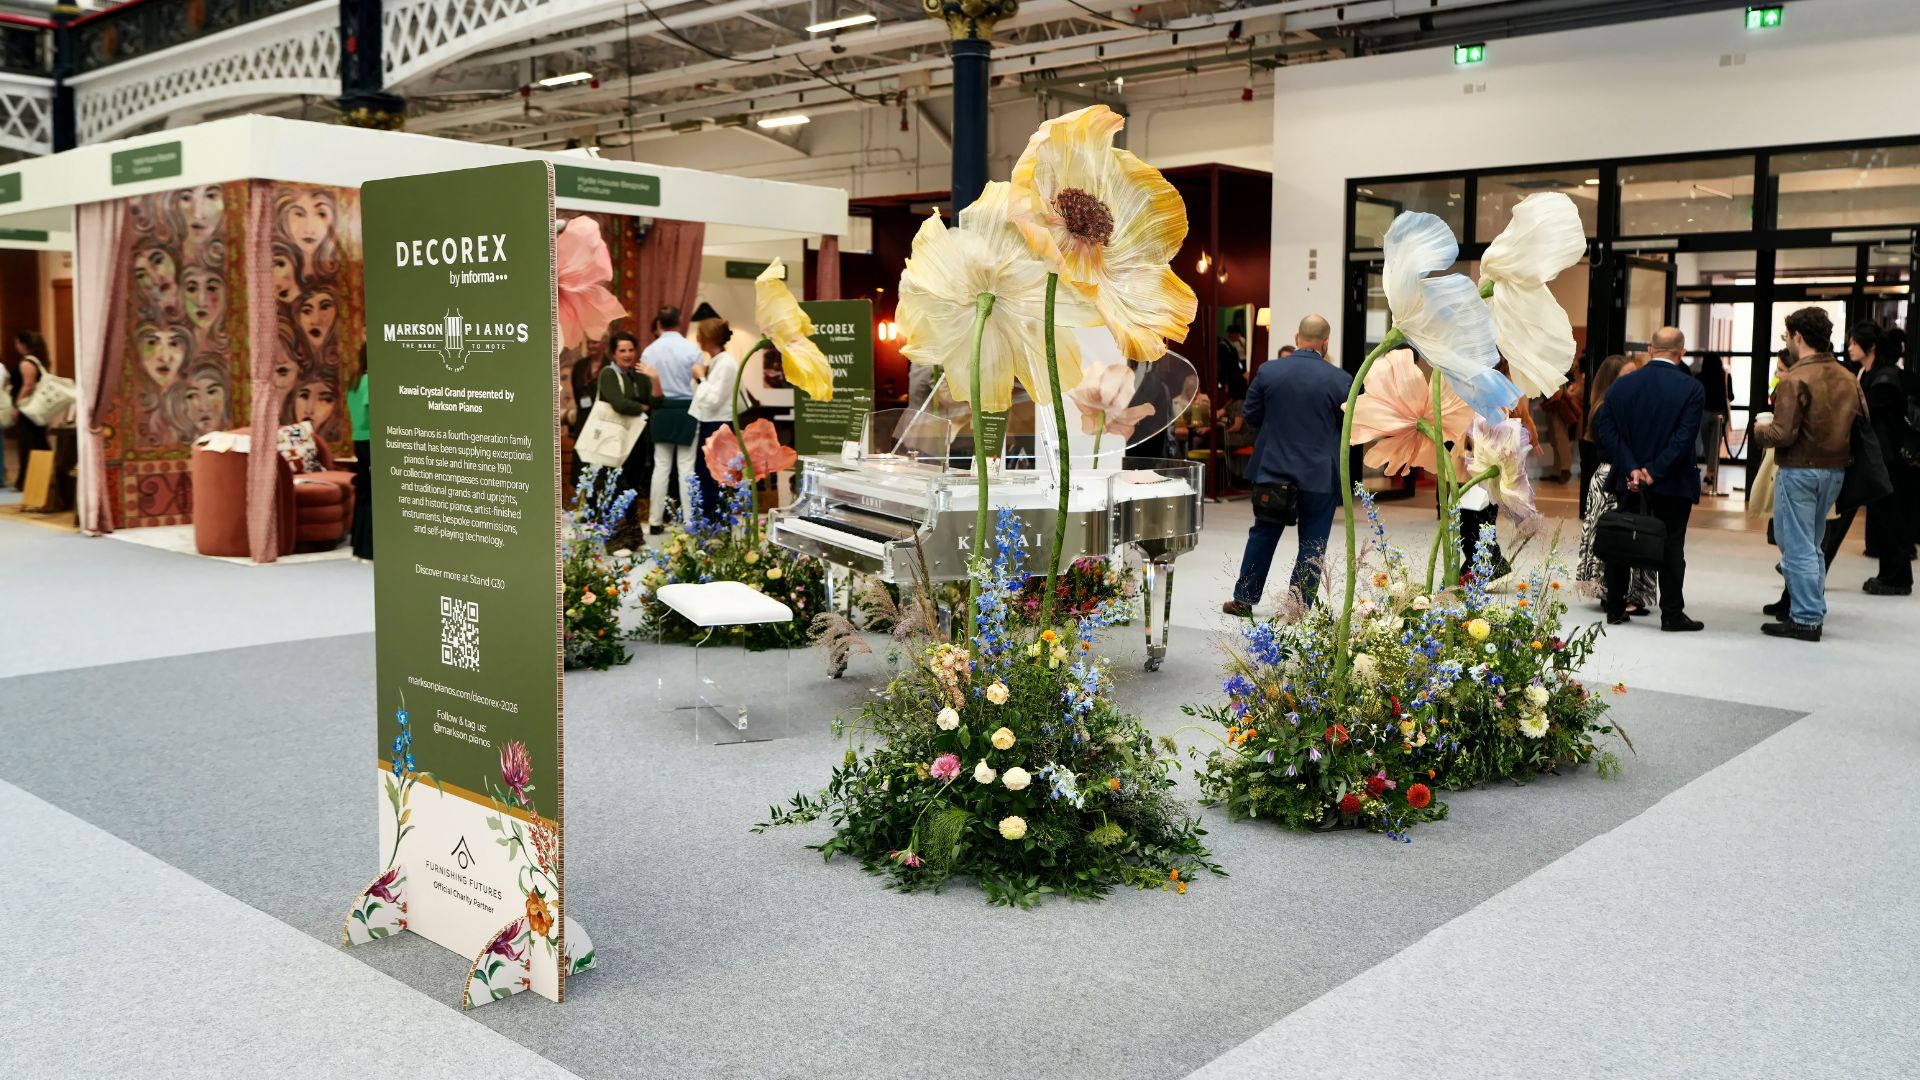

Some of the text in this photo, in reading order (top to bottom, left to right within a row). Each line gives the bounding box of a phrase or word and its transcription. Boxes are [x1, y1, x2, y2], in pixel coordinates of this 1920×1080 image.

[396, 234, 507, 267] DECOREX
[450, 270, 494, 287] by informa
[384, 323, 529, 342] MARKSON PIANOS
[814, 324, 855, 335] ECOREX
[399, 385, 514, 402] Kawai Crystal Grand presented by
[428, 401, 482, 413] Markson Pianos
[387, 426, 413, 436] Markson
[414, 428, 435, 438] Pianos
[436, 429, 442, 438] is
[448, 430, 508, 444] fourth-generation
[510, 434, 532, 448] family
[386, 438, 533, 461] business that has been supplying exceptional
[404, 455, 513, 474] pianos for sale and hire since 1910.
[390, 467, 530, 493] Our collection encompasses contemporary
[401, 482, 518, 506] and traditional grands and uprights,
[399, 496, 522, 519] rare and historic pianos, artist-finished
[402, 508, 518, 535] instruments, bespoke commissions,
[414, 524, 504, 548] and self-playing technology.
[958, 534, 1042, 549] KAI
[416, 564, 505, 590] Discover more at Stand G30
[408, 676, 519, 714] marksonpianos.com/decorex-2026
[437, 710, 486, 733] Follow & tag us:
[434, 722, 491, 748] @markson.pianos
[426, 860, 502, 900] FURNISHING FUTURES
[433, 880, 494, 914] Official Charity Partner
